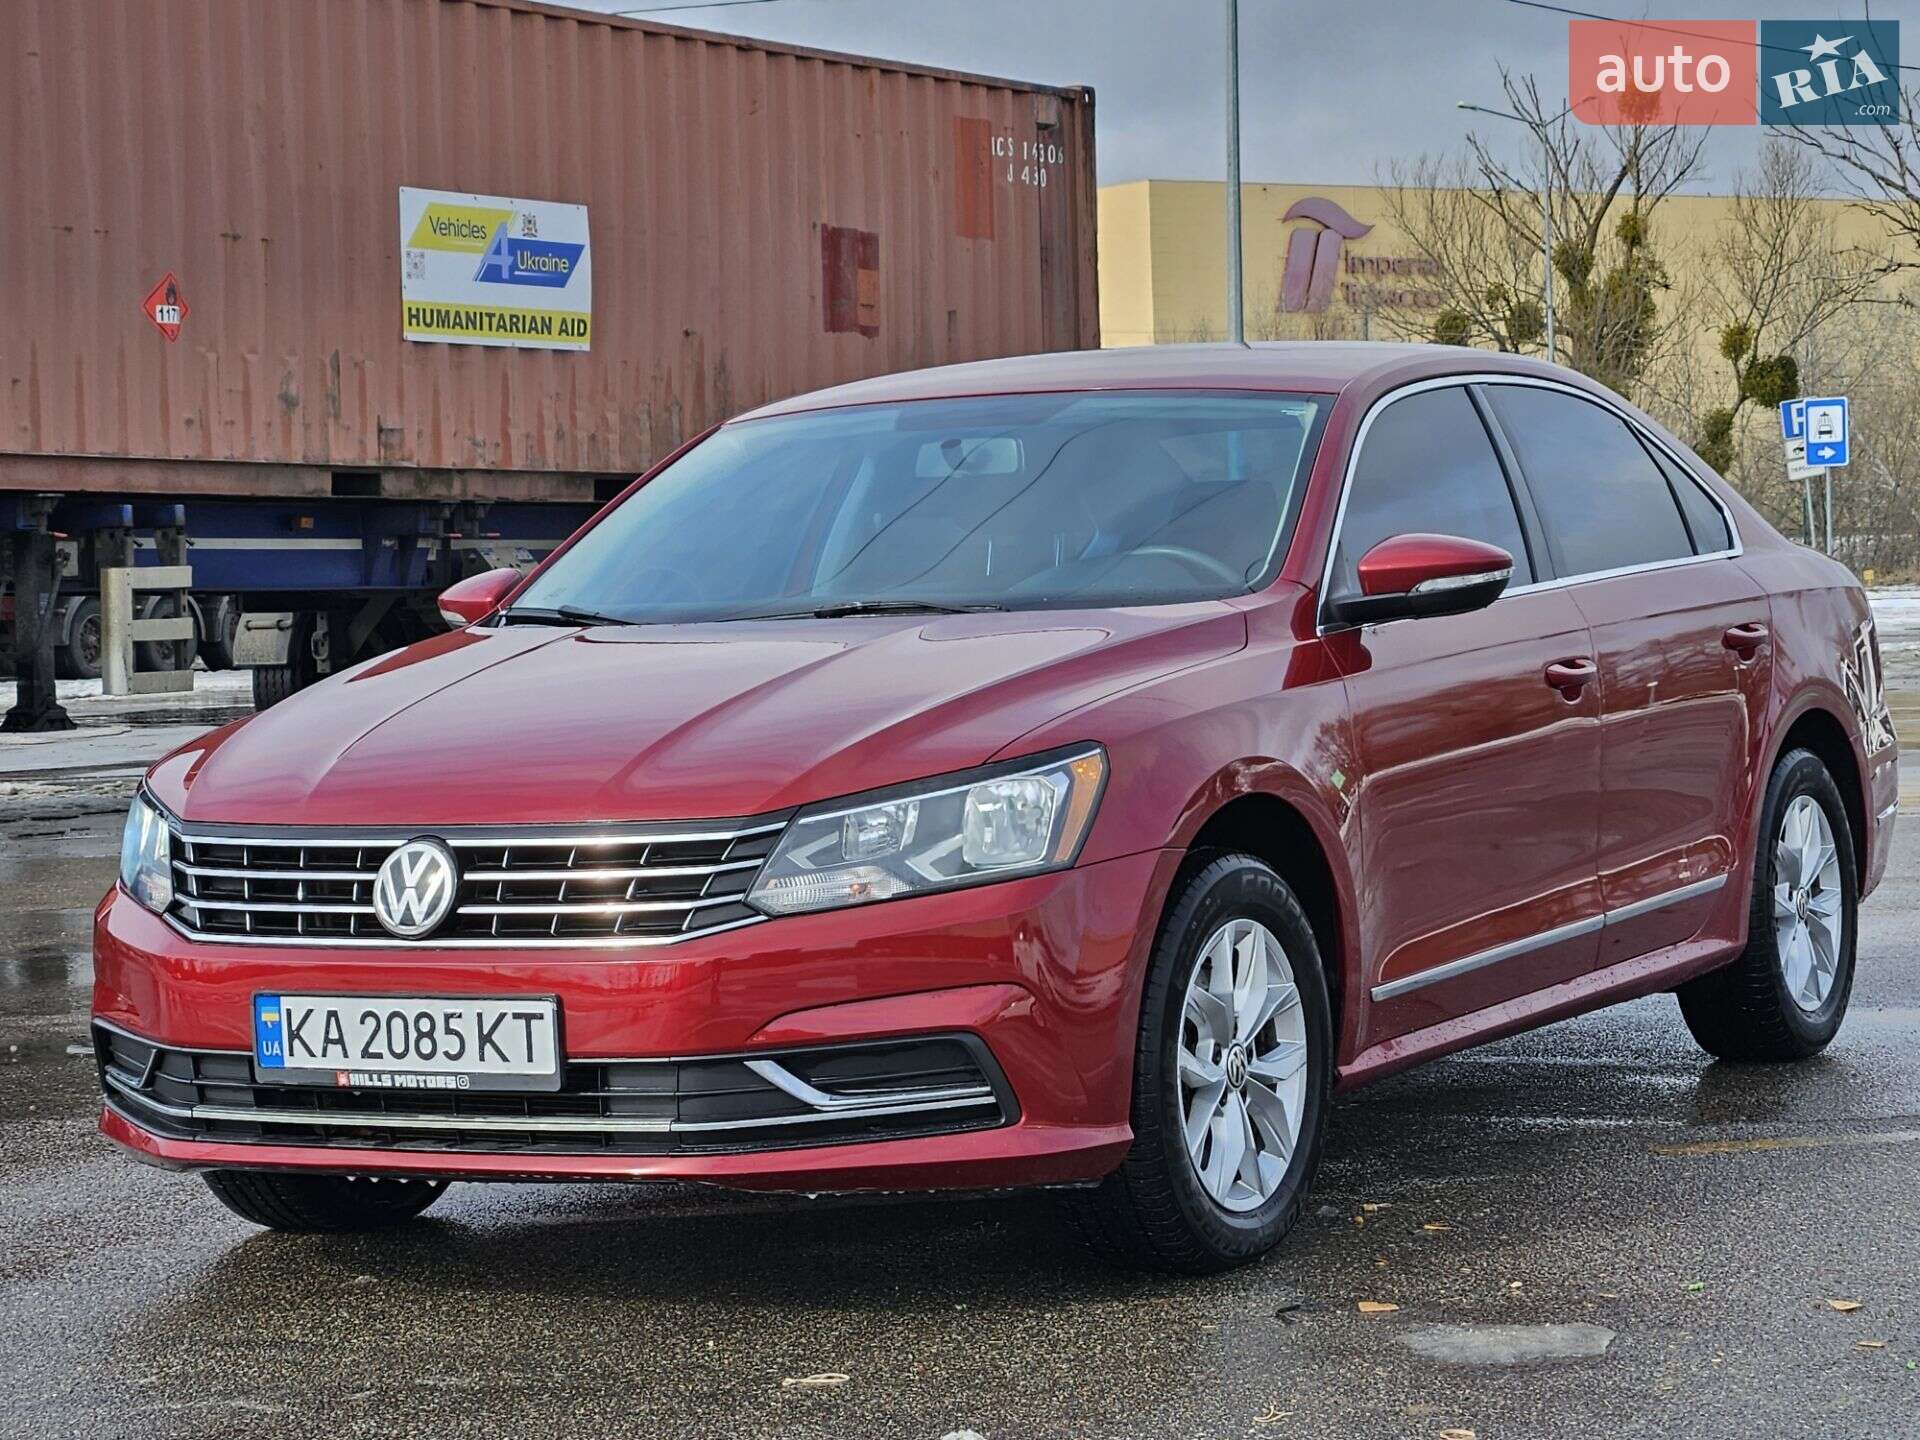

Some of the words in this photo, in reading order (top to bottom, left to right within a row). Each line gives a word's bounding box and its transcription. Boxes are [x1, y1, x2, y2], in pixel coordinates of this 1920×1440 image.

[991, 136, 1014, 157] ICS
[429, 214, 487, 240] Vehicles
[516, 249, 570, 273] Ukraine
[407, 306, 553, 336] HUMANITARIAN
[557, 316, 588, 338] AID
[286, 1007, 350, 1058] KA
[359, 1009, 467, 1062] 2085
[476, 1011, 545, 1063] KT
[263, 1040, 282, 1057] UA
